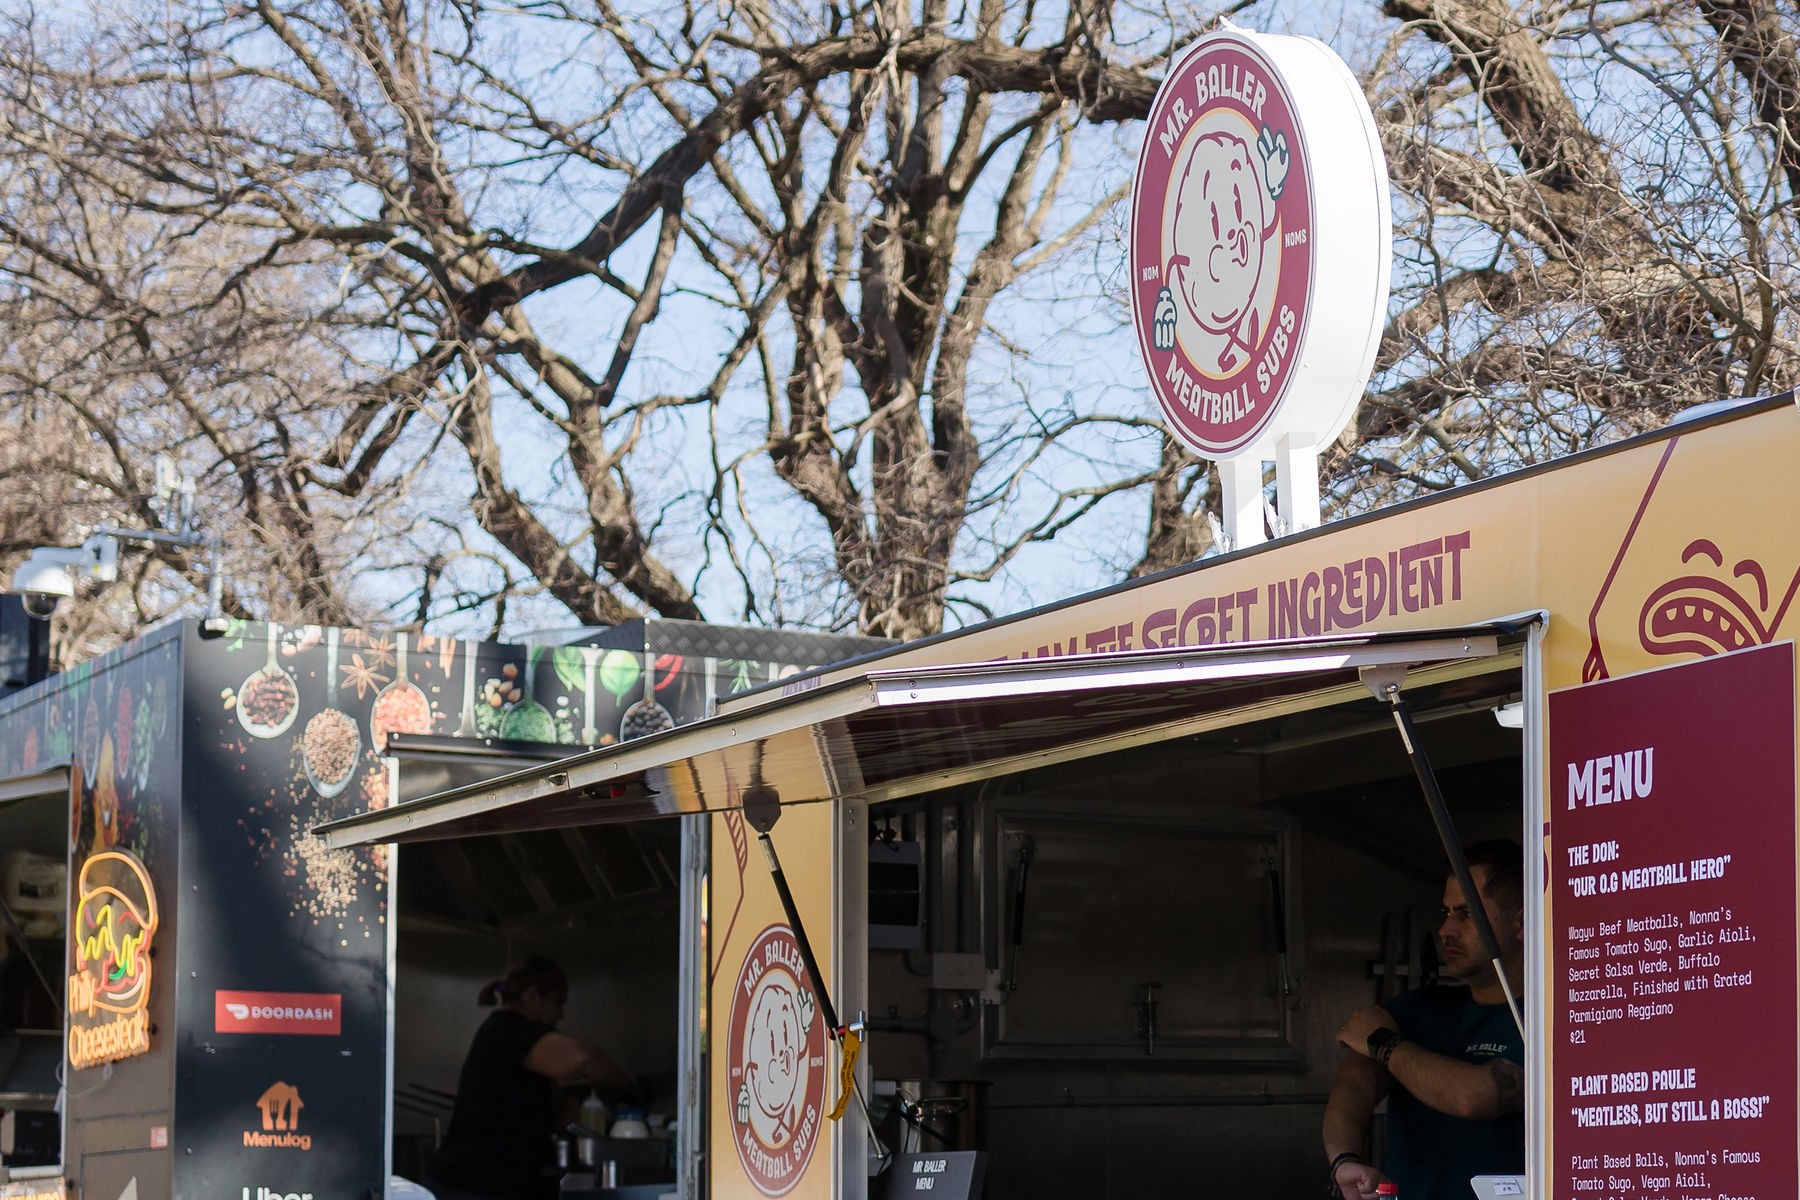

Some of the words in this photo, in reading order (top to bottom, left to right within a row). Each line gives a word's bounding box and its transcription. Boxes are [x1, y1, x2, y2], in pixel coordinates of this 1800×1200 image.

[1158, 97, 1195, 158] MR.
[1195, 65, 1267, 120] BALLER
[1285, 229, 1306, 248] NOMS
[1142, 265, 1159, 281] NOM
[1164, 353, 1255, 424] MEATBALL
[1257, 305, 1295, 394] SUBS
[1267, 531, 1471, 638] INGREDIENT
[1568, 747, 1654, 810] MENU
[1568, 845, 1589, 867] THE
[1593, 840, 1619, 864] DON:
[1600, 872, 1618, 894] O.G
[1622, 862, 1687, 890] MEATBALL
[1568, 926, 1595, 942] Wagyu
[1600, 920, 1621, 936] Beef
[1627, 914, 1683, 932] Meatballs,
[1689, 907, 1732, 925] Nonna’s
[1569, 946, 1600, 961] Famous
[1605, 940, 1639, 956] Tomato
[1644, 937, 1672, 954] Sugo,
[1678, 932, 1714, 948] Garlic
[1719, 926, 1756, 944] Aioli,
[744, 963, 763, 997] MR.
[765, 940, 804, 980] BALLER
[1569, 967, 1600, 982] Secret
[1605, 963, 1634, 978] Salsa
[1639, 958, 1672, 973] Verde,
[1678, 952, 1720, 970] Buffalo
[69, 969, 97, 1018] Philly
[1569, 984, 1627, 1002] Mozzarella,
[1633, 978, 1679, 995] Finished
[1684, 976, 1708, 991] with
[1714, 970, 1752, 987] Grated
[251, 1006, 334, 1019] DOORDASH
[1569, 1007, 1623, 1024] Parmigiano
[1628, 1002, 1673, 1020] Reggiano
[69, 1007, 148, 1067] Cheesesteak
[1570, 1030, 1586, 1043] $21
[1571, 1075, 1607, 1096] PLANT
[1611, 1072, 1649, 1094] BASED
[1652, 1068, 1696, 1090] PAULIE
[1645, 1102, 1668, 1124] BUT
[1672, 1101, 1707, 1122] STILL
[1711, 1100, 1720, 1120] A
[243, 1131, 311, 1150] Menulog
[743, 1128, 793, 1179] MEATBALL
[793, 1103, 816, 1160] SUBS
[923, 1160, 947, 1173] BALLER
[1572, 1156, 1598, 1169] Plant
[1604, 1154, 1631, 1168] Based
[1635, 1153, 1669, 1168] Balls,
[1675, 1150, 1717, 1166] Nonna’s
[1723, 1150, 1760, 1164] Famous
[915, 1177, 934, 1190] MENU
[1571, 1177, 1604, 1190] Tomato
[1608, 1175, 1635, 1192] Sugo,
[1641, 1175, 1671, 1192] Vegan
[1676, 1173, 1711, 1189] Aioli,
